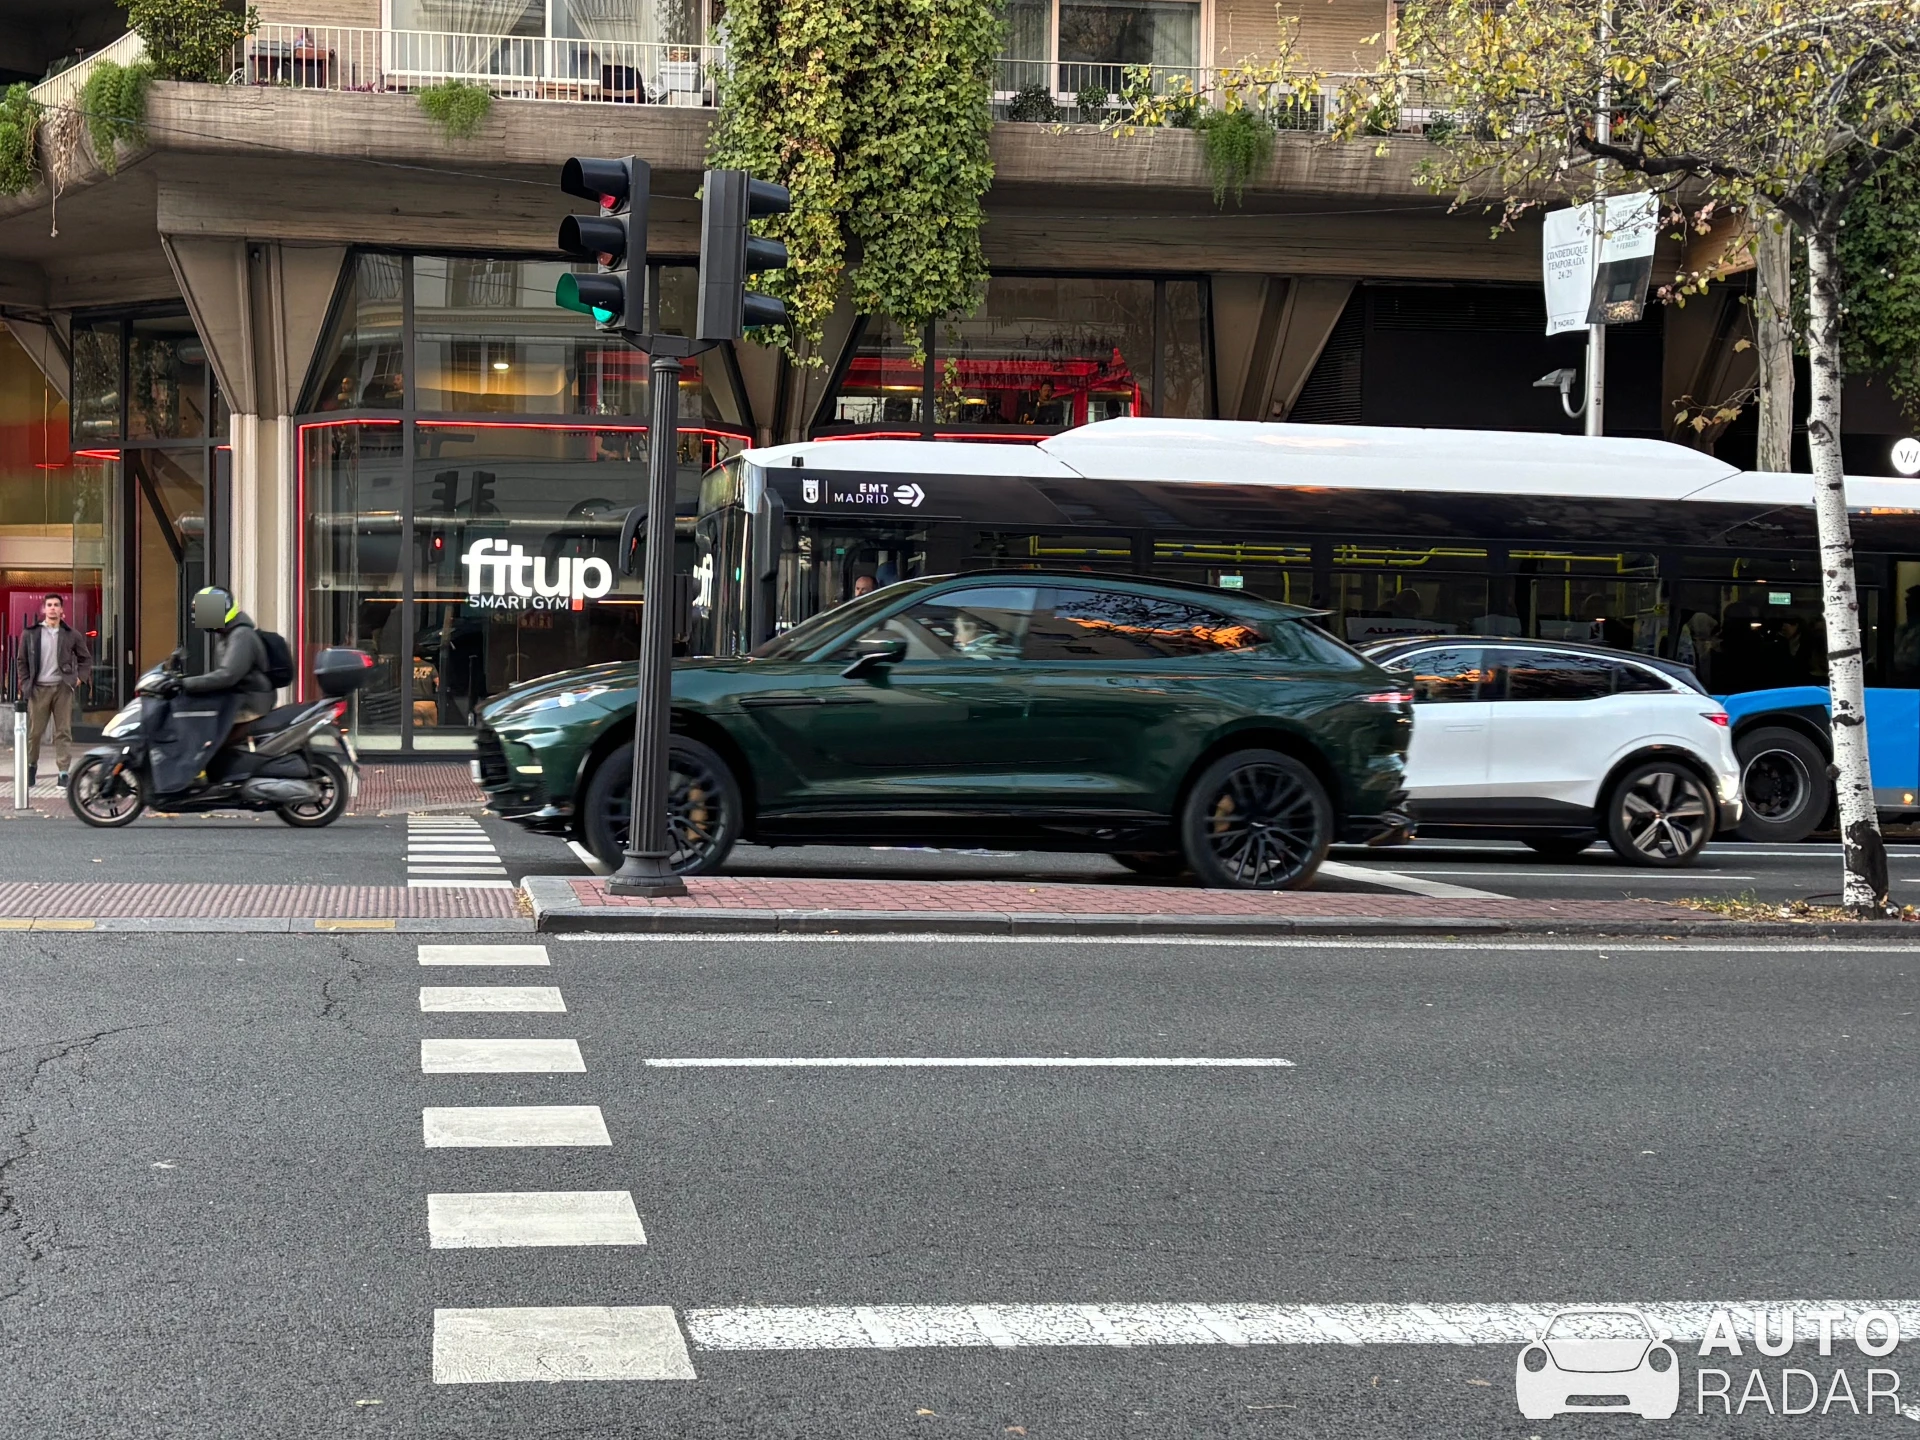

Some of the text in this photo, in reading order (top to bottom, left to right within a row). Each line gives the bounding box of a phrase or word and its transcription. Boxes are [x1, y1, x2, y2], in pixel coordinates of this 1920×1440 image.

[1547, 245, 1589, 261] CONDEDUQUE
[1548, 257, 1586, 271] TEMPORADA
[1557, 319, 1576, 328] MADRID
[859, 483, 889, 493] EMT
[834, 492, 889, 505] MADRID
[461, 538, 613, 611] fitup
[469, 595, 569, 610] SMART GYM
